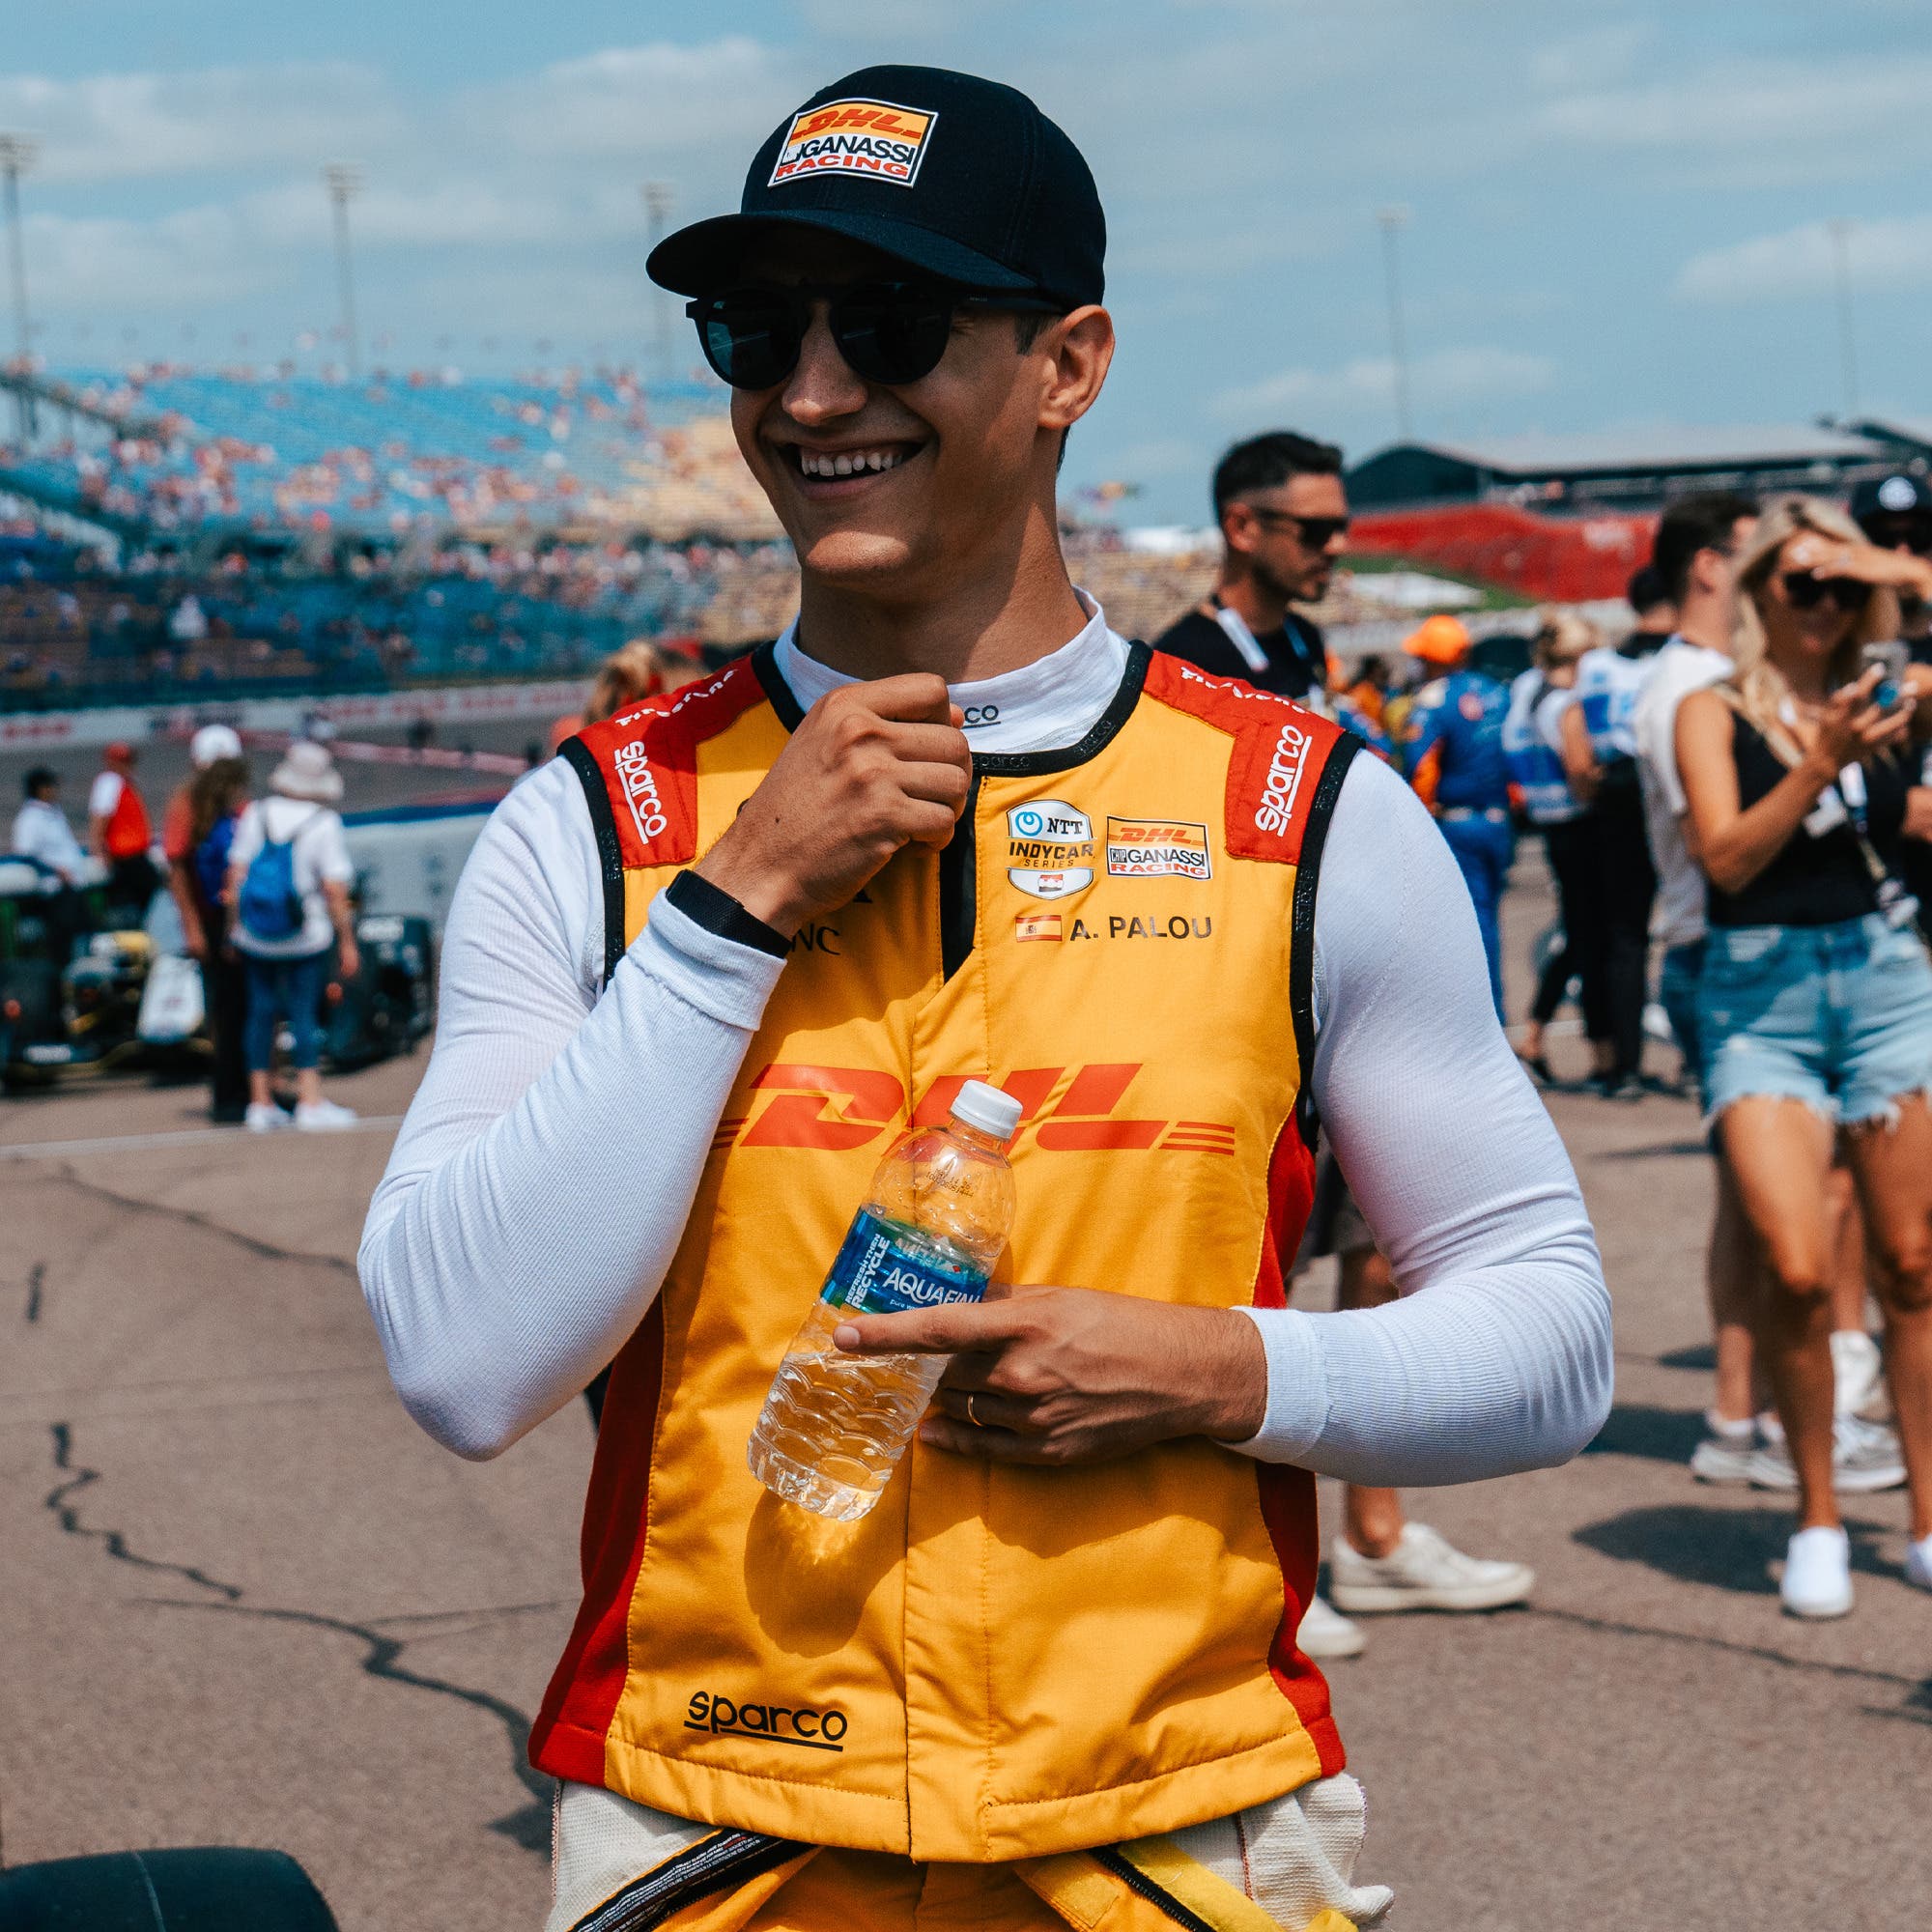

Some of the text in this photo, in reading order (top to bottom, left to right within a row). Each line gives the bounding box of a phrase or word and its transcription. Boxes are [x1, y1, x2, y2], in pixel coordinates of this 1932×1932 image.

[806, 109, 903, 134] DHL
[803, 136, 916, 165] GANASSI
[775, 155, 909, 178] RACING
[614, 741, 668, 838] sparco
[1255, 724, 1307, 834] sparco
[1047, 817, 1083, 835] NTT
[1121, 827, 1191, 843] DHL
[1009, 841, 1094, 860] INDYCAR
[1024, 859, 1074, 868] SERIES
[1127, 849, 1205, 867] GANASSI
[1111, 863, 1206, 875] RACING
[1069, 916, 1211, 942] A. PALOU
[739, 1063, 1169, 1151] DHL
[845, 1234, 881, 1303] REFRESH THEN
[851, 1236, 890, 1309] RECYCLE
[882, 1266, 980, 1304] AQUAFIN
[687, 1690, 848, 1744] sparco
